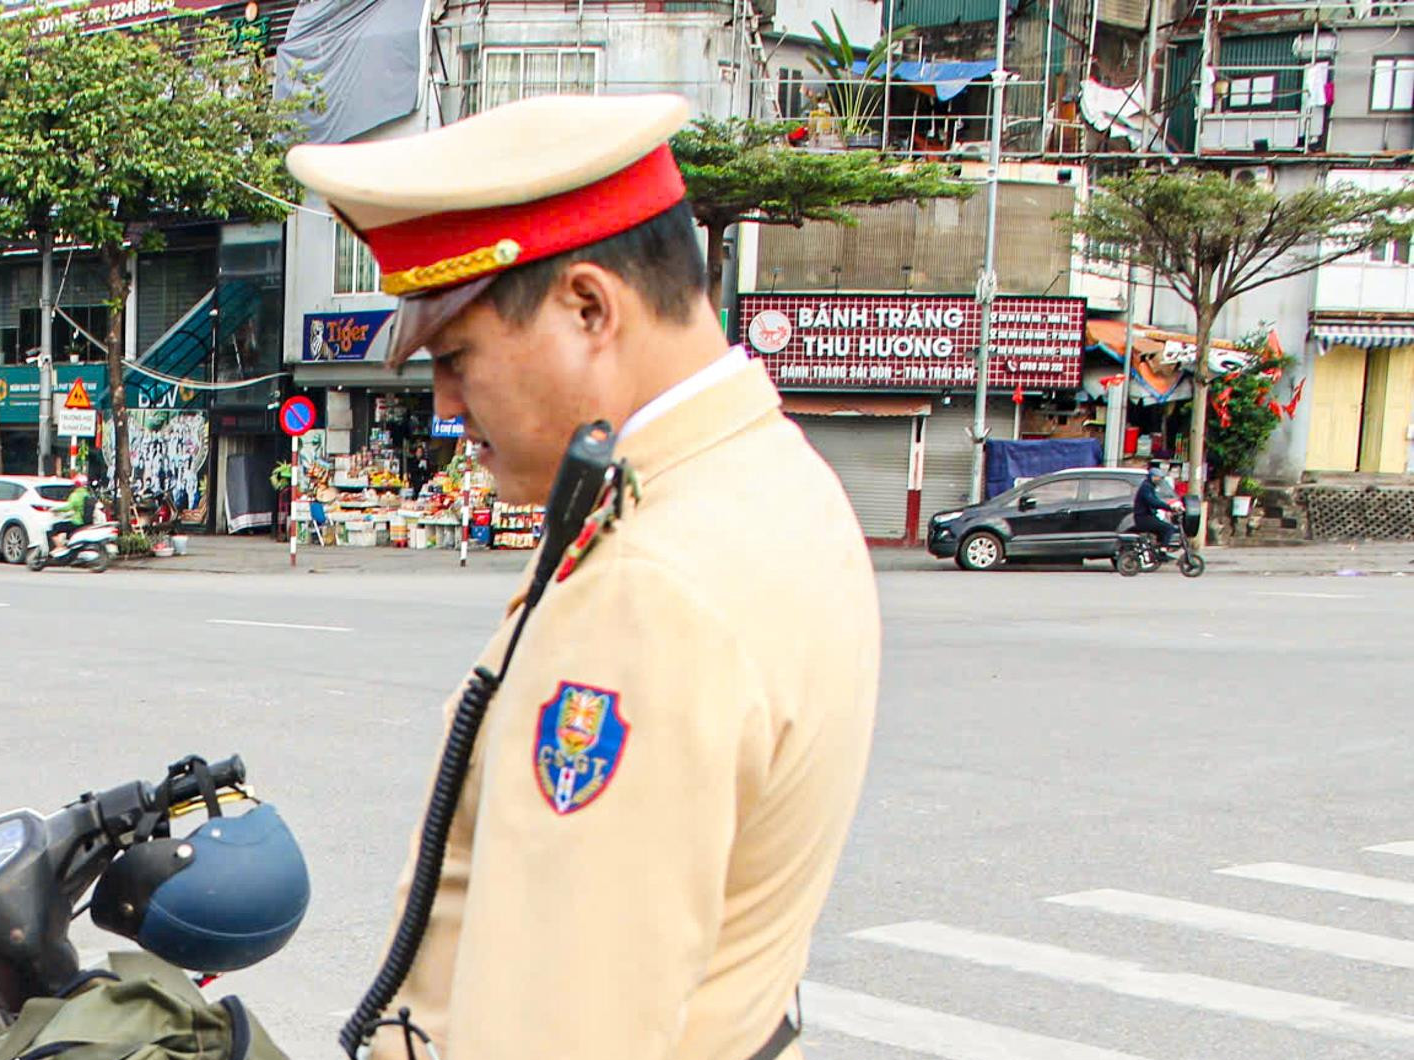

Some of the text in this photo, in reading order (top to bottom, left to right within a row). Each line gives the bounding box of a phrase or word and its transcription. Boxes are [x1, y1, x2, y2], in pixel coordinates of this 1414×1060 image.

[797, 303, 964, 329] BÁNH TRÁNG
[327, 318, 369, 352] Tiger
[803, 334, 954, 358] THU HƯƠNG
